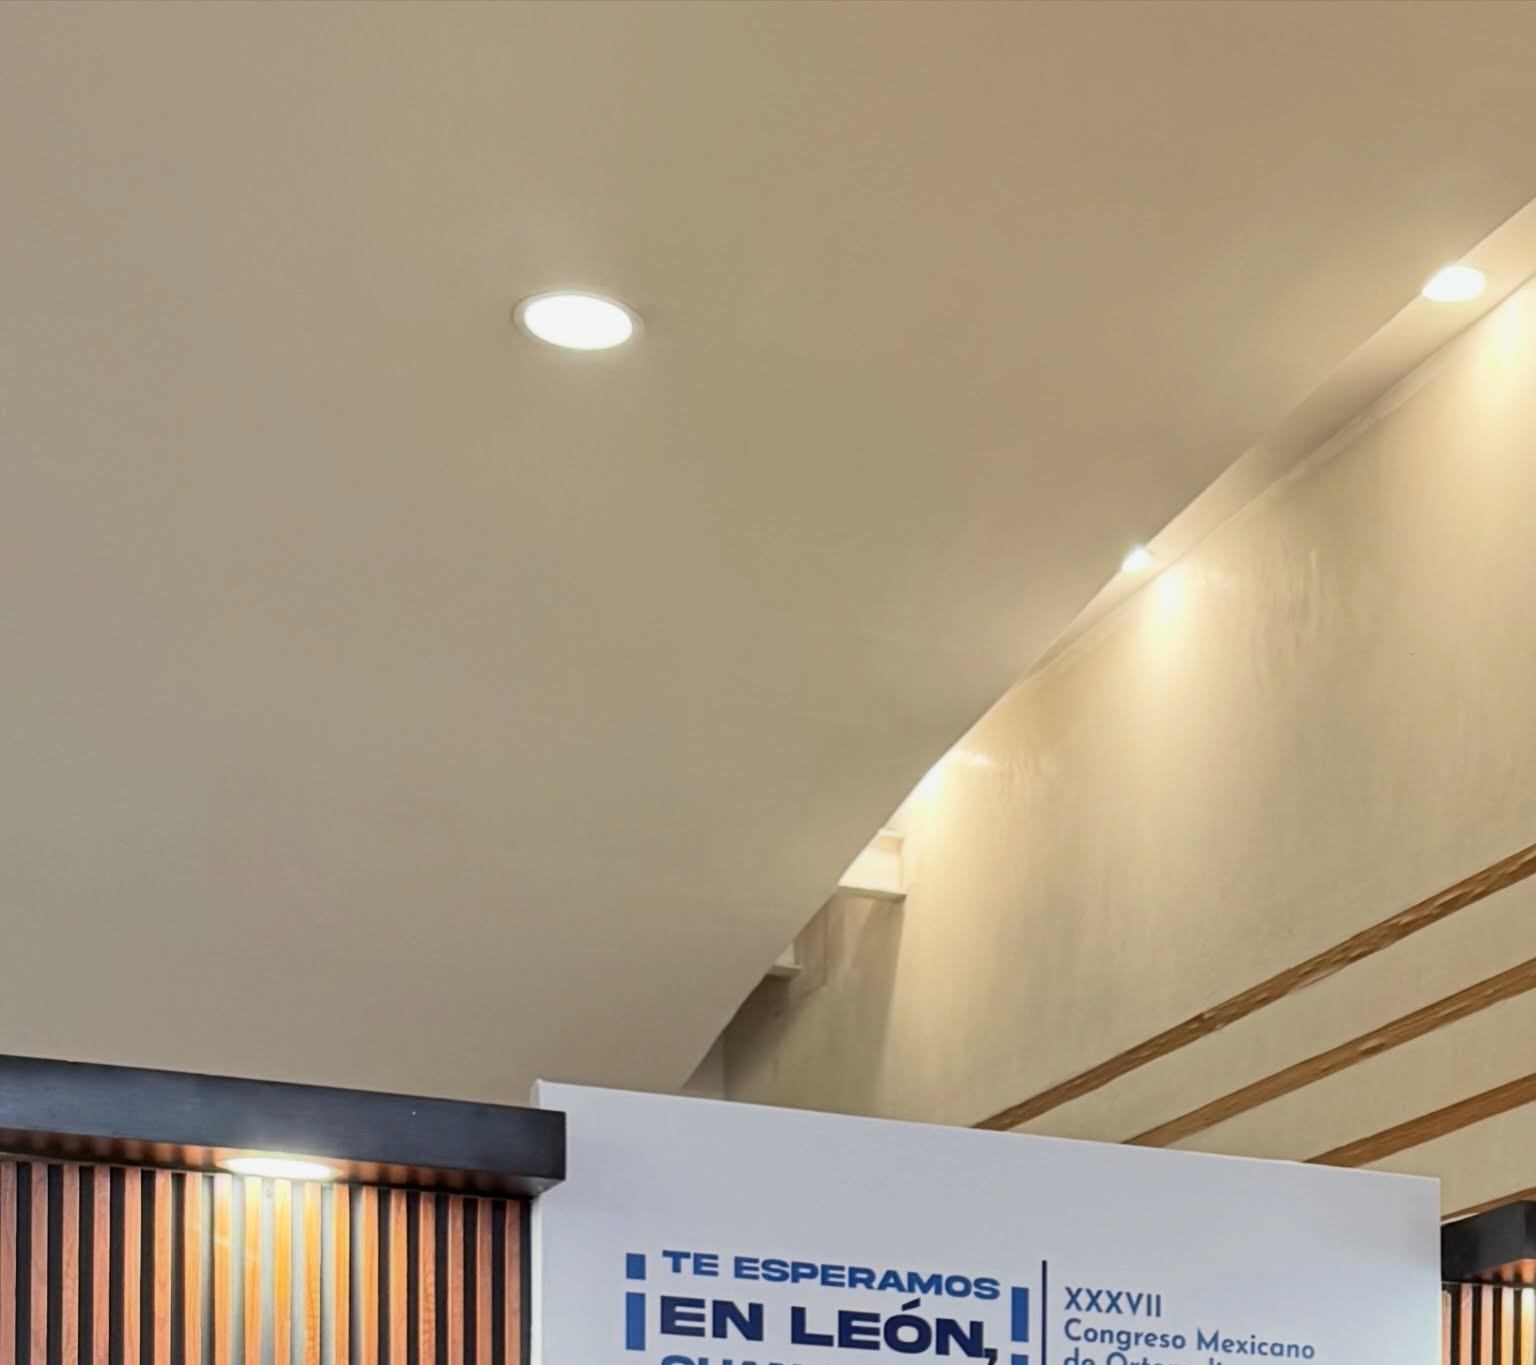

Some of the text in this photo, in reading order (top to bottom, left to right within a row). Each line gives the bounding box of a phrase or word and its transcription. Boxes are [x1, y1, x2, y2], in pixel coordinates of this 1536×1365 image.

[662, 1249, 1001, 1301] TE ESPERAMOS
[660, 1294, 764, 1342] EN
[1064, 1286, 1162, 1318] XXXVII
[1063, 1318, 1315, 1360] Congreso Mexicano
